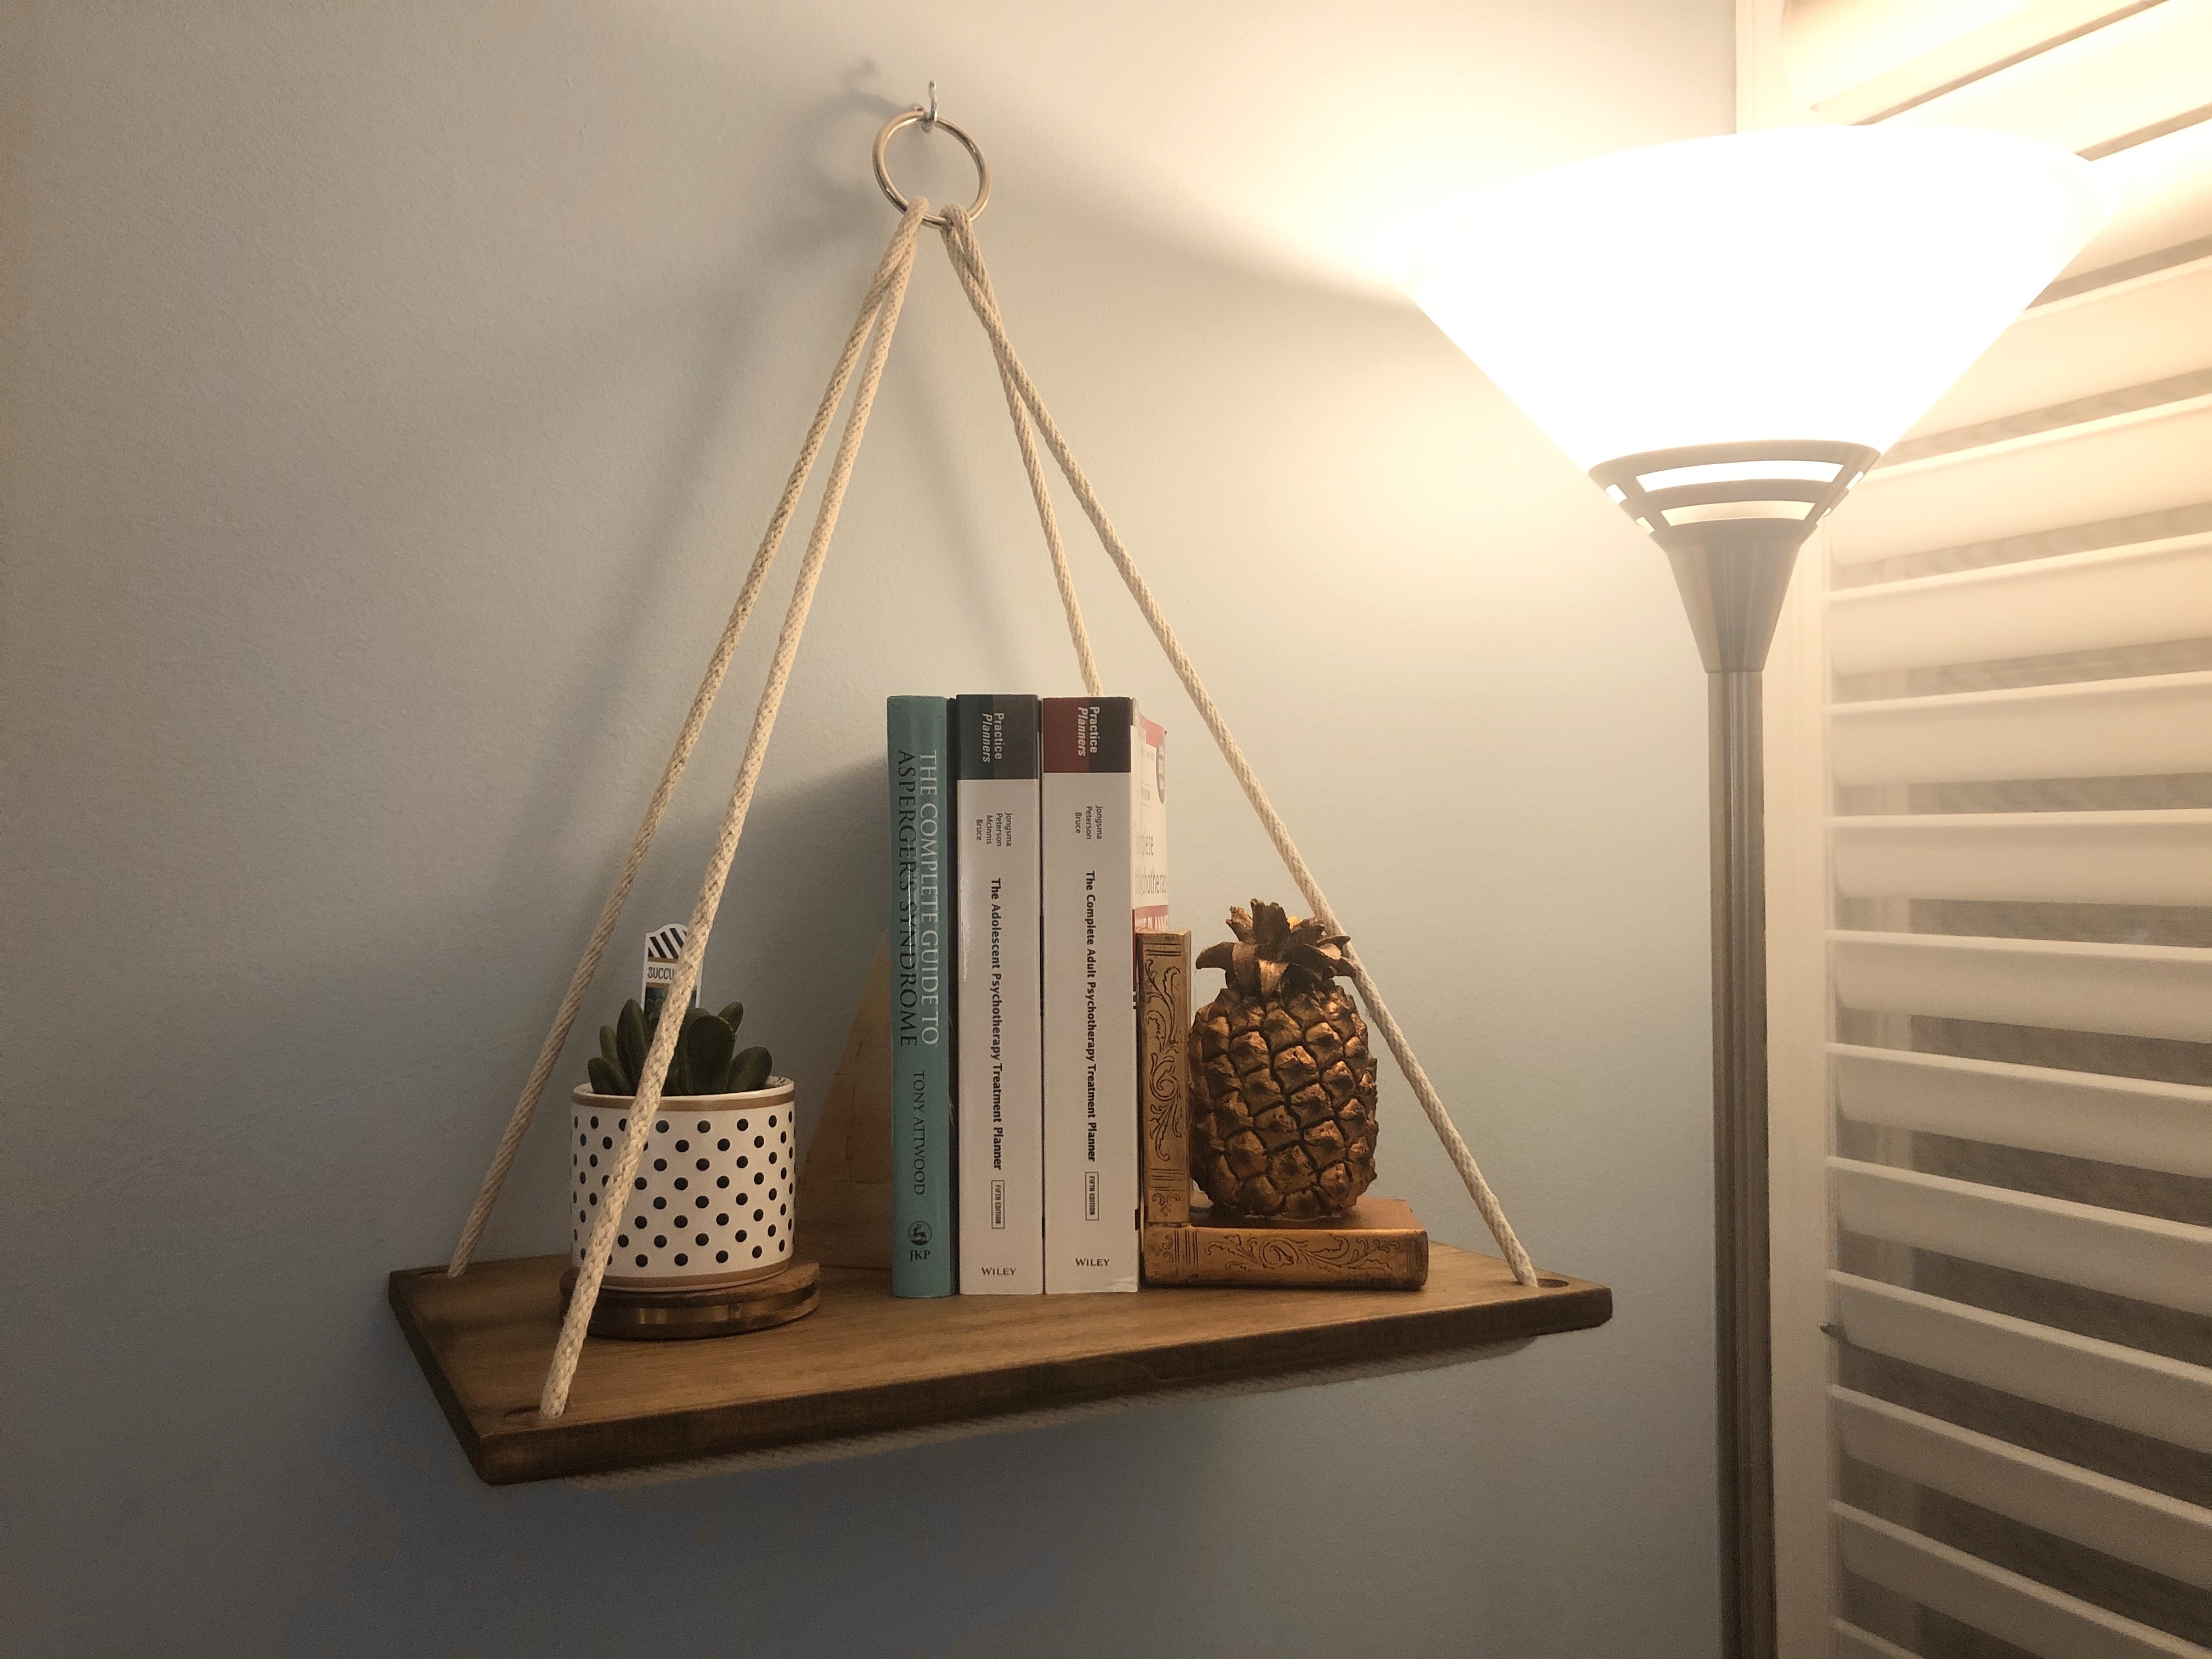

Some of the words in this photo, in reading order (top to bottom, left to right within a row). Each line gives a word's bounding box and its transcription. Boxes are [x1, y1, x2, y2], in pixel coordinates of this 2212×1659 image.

[982, 713, 992, 763] Planners
[994, 713, 1005, 760] Practice
[1077, 707, 1088, 757] Planners
[1090, 706, 1101, 753] Practice
[920, 749, 938, 795] THE
[1005, 811, 1013, 847] Jongsma
[1095, 805, 1103, 839] Jongsma
[920, 803, 939, 923] COMPLETE
[1086, 871, 1096, 891] The
[991, 878, 1002, 900] The
[991, 904, 1002, 969] Adolescent
[1085, 894, 1097, 945] Complete
[647, 966, 675, 980] SUCCU
[899, 901, 918, 1046] SYNDROME
[921, 929, 939, 1005] GUIDE
[1087, 948, 1097, 978] Adult
[921, 1011, 939, 1045] TO
[990, 973, 1003, 1060] Psychotherapy
[1085, 981, 1097, 1062] Psychotherapy
[913, 1070, 925, 1113] TONY
[992, 1063, 1003, 1123] Treatment
[1087, 1063, 1097, 1118] Treatment
[913, 1116, 926, 1195] ATTWOOD
[993, 1127, 1004, 1170] Planner
[1087, 1122, 1097, 1162] Planner
[909, 1250, 931, 1262] JKP
[981, 1267, 1016, 1276] WILEY
[1075, 1257, 1110, 1267] WILEY
